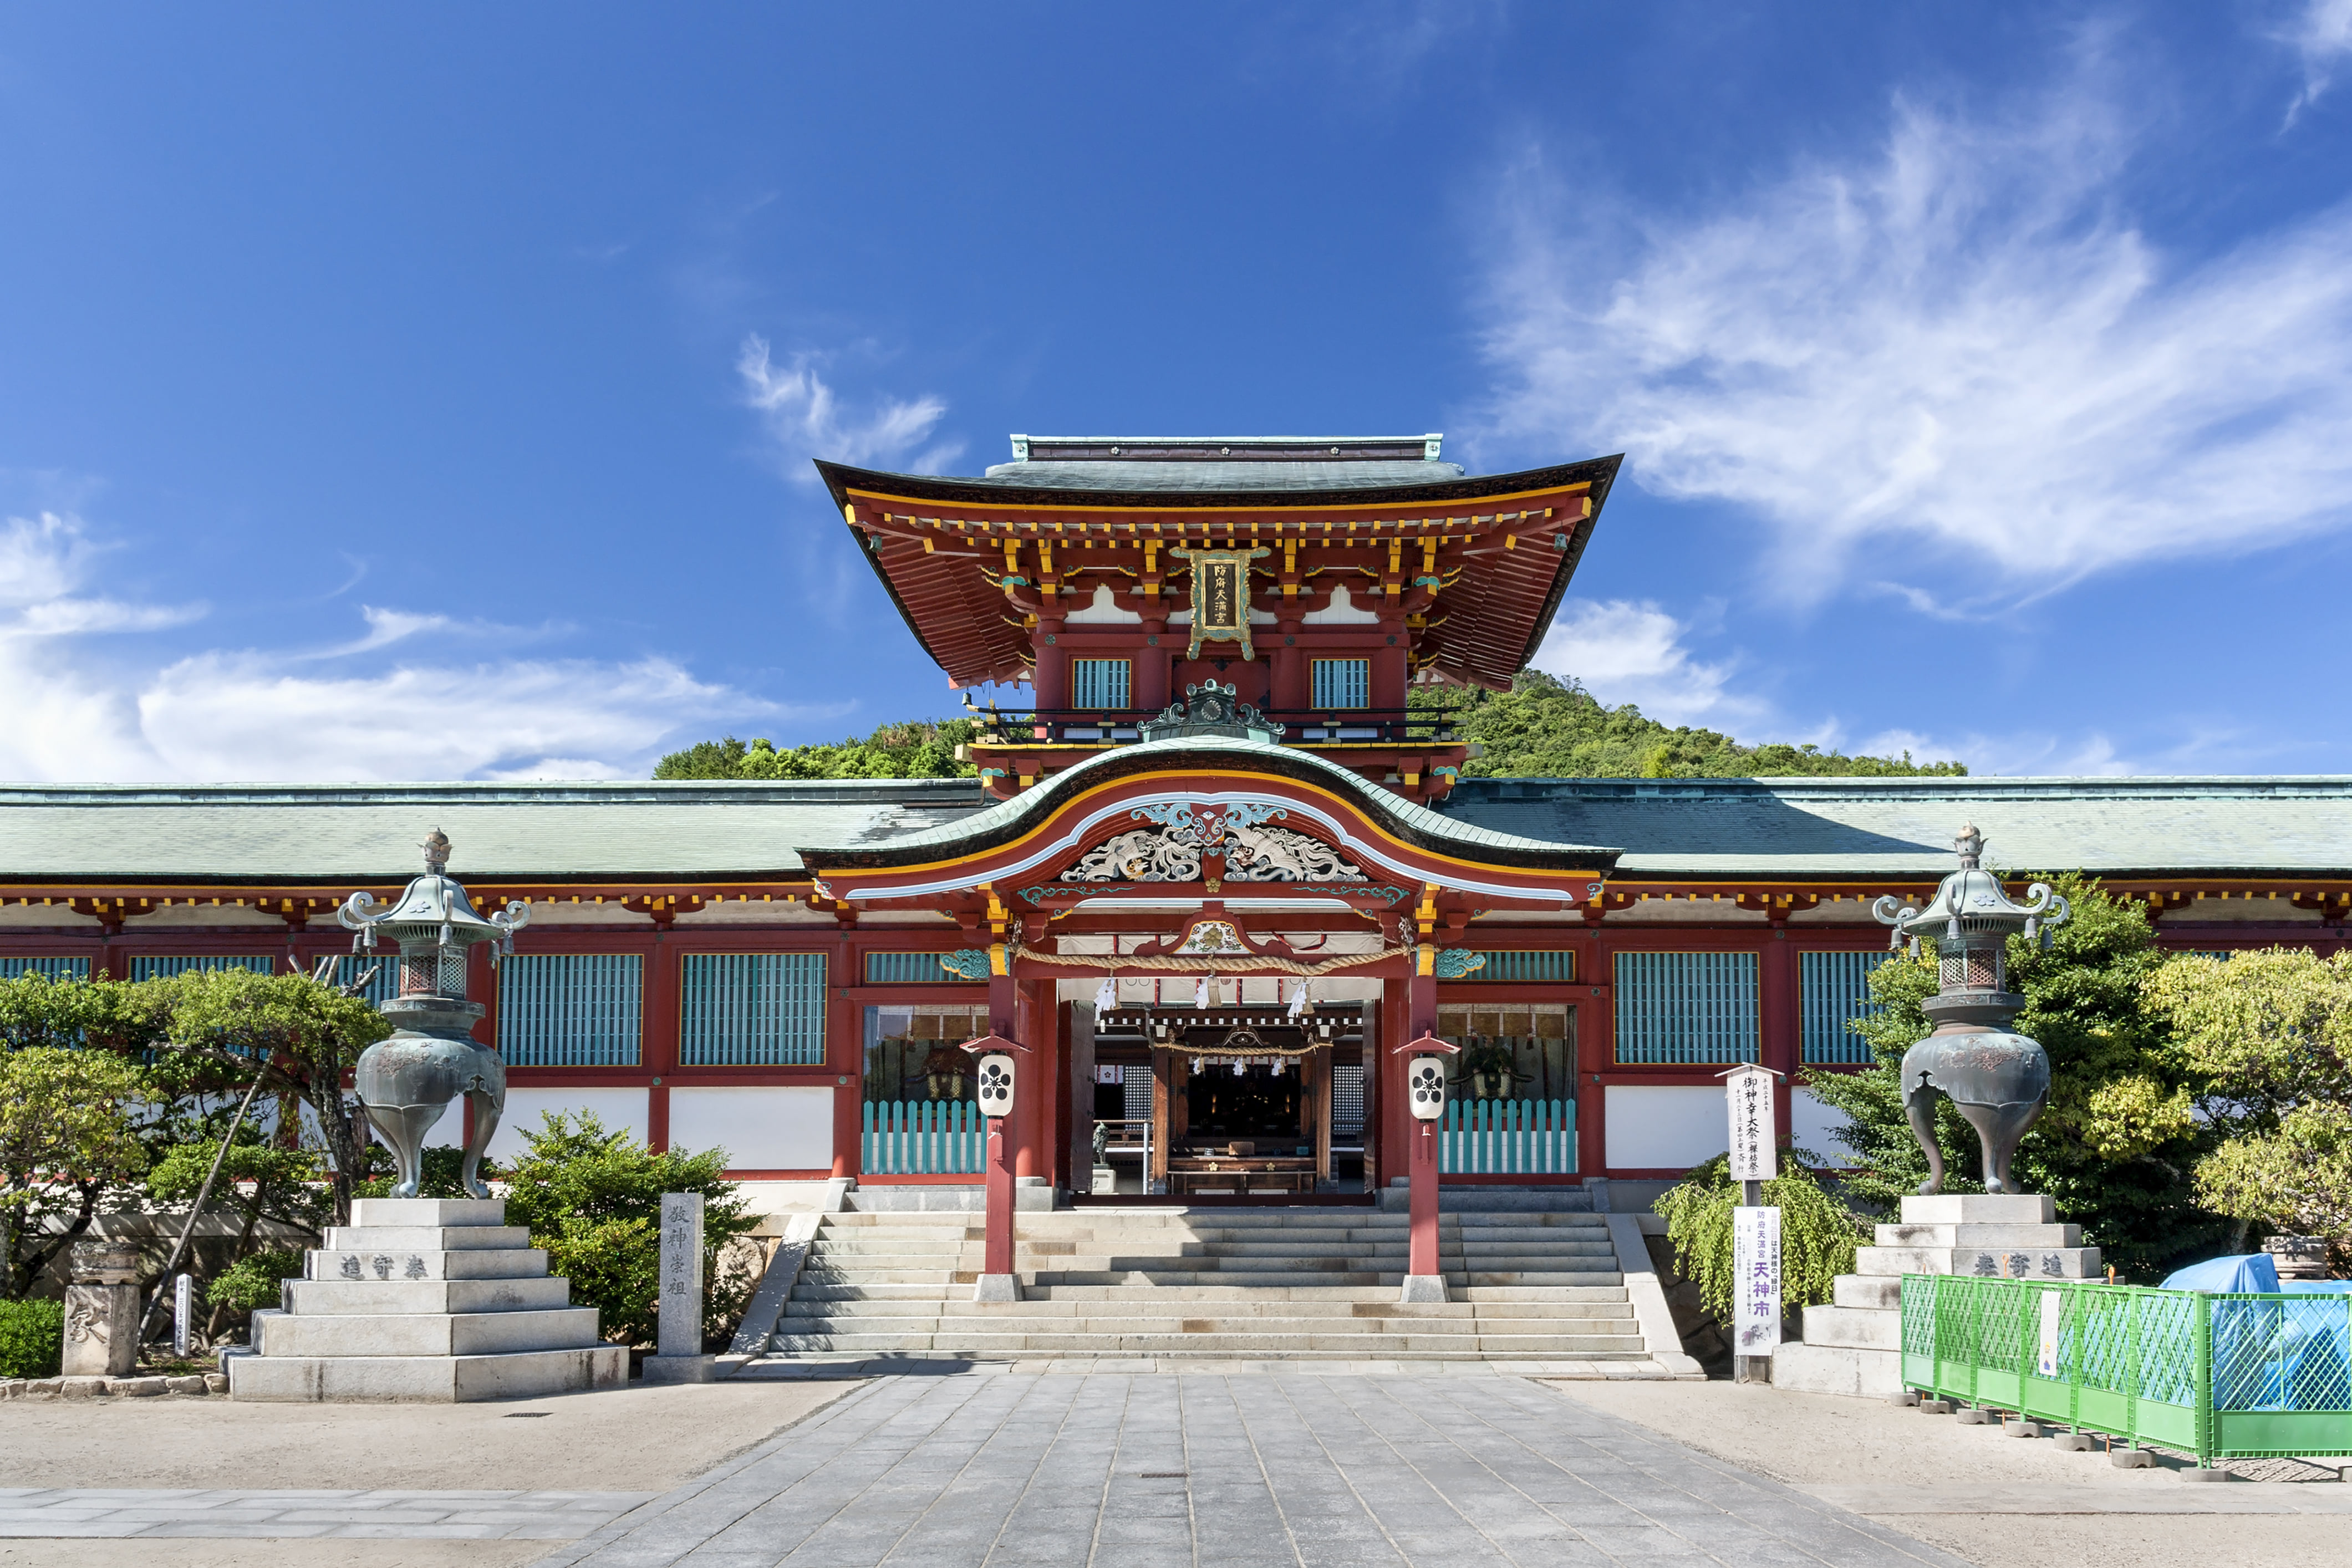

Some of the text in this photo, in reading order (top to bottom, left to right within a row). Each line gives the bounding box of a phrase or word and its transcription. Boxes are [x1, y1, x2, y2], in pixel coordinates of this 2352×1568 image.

[667, 1206, 690, 1295] 敬神崇祖
[1753, 1262, 1770, 1317] 天神市
